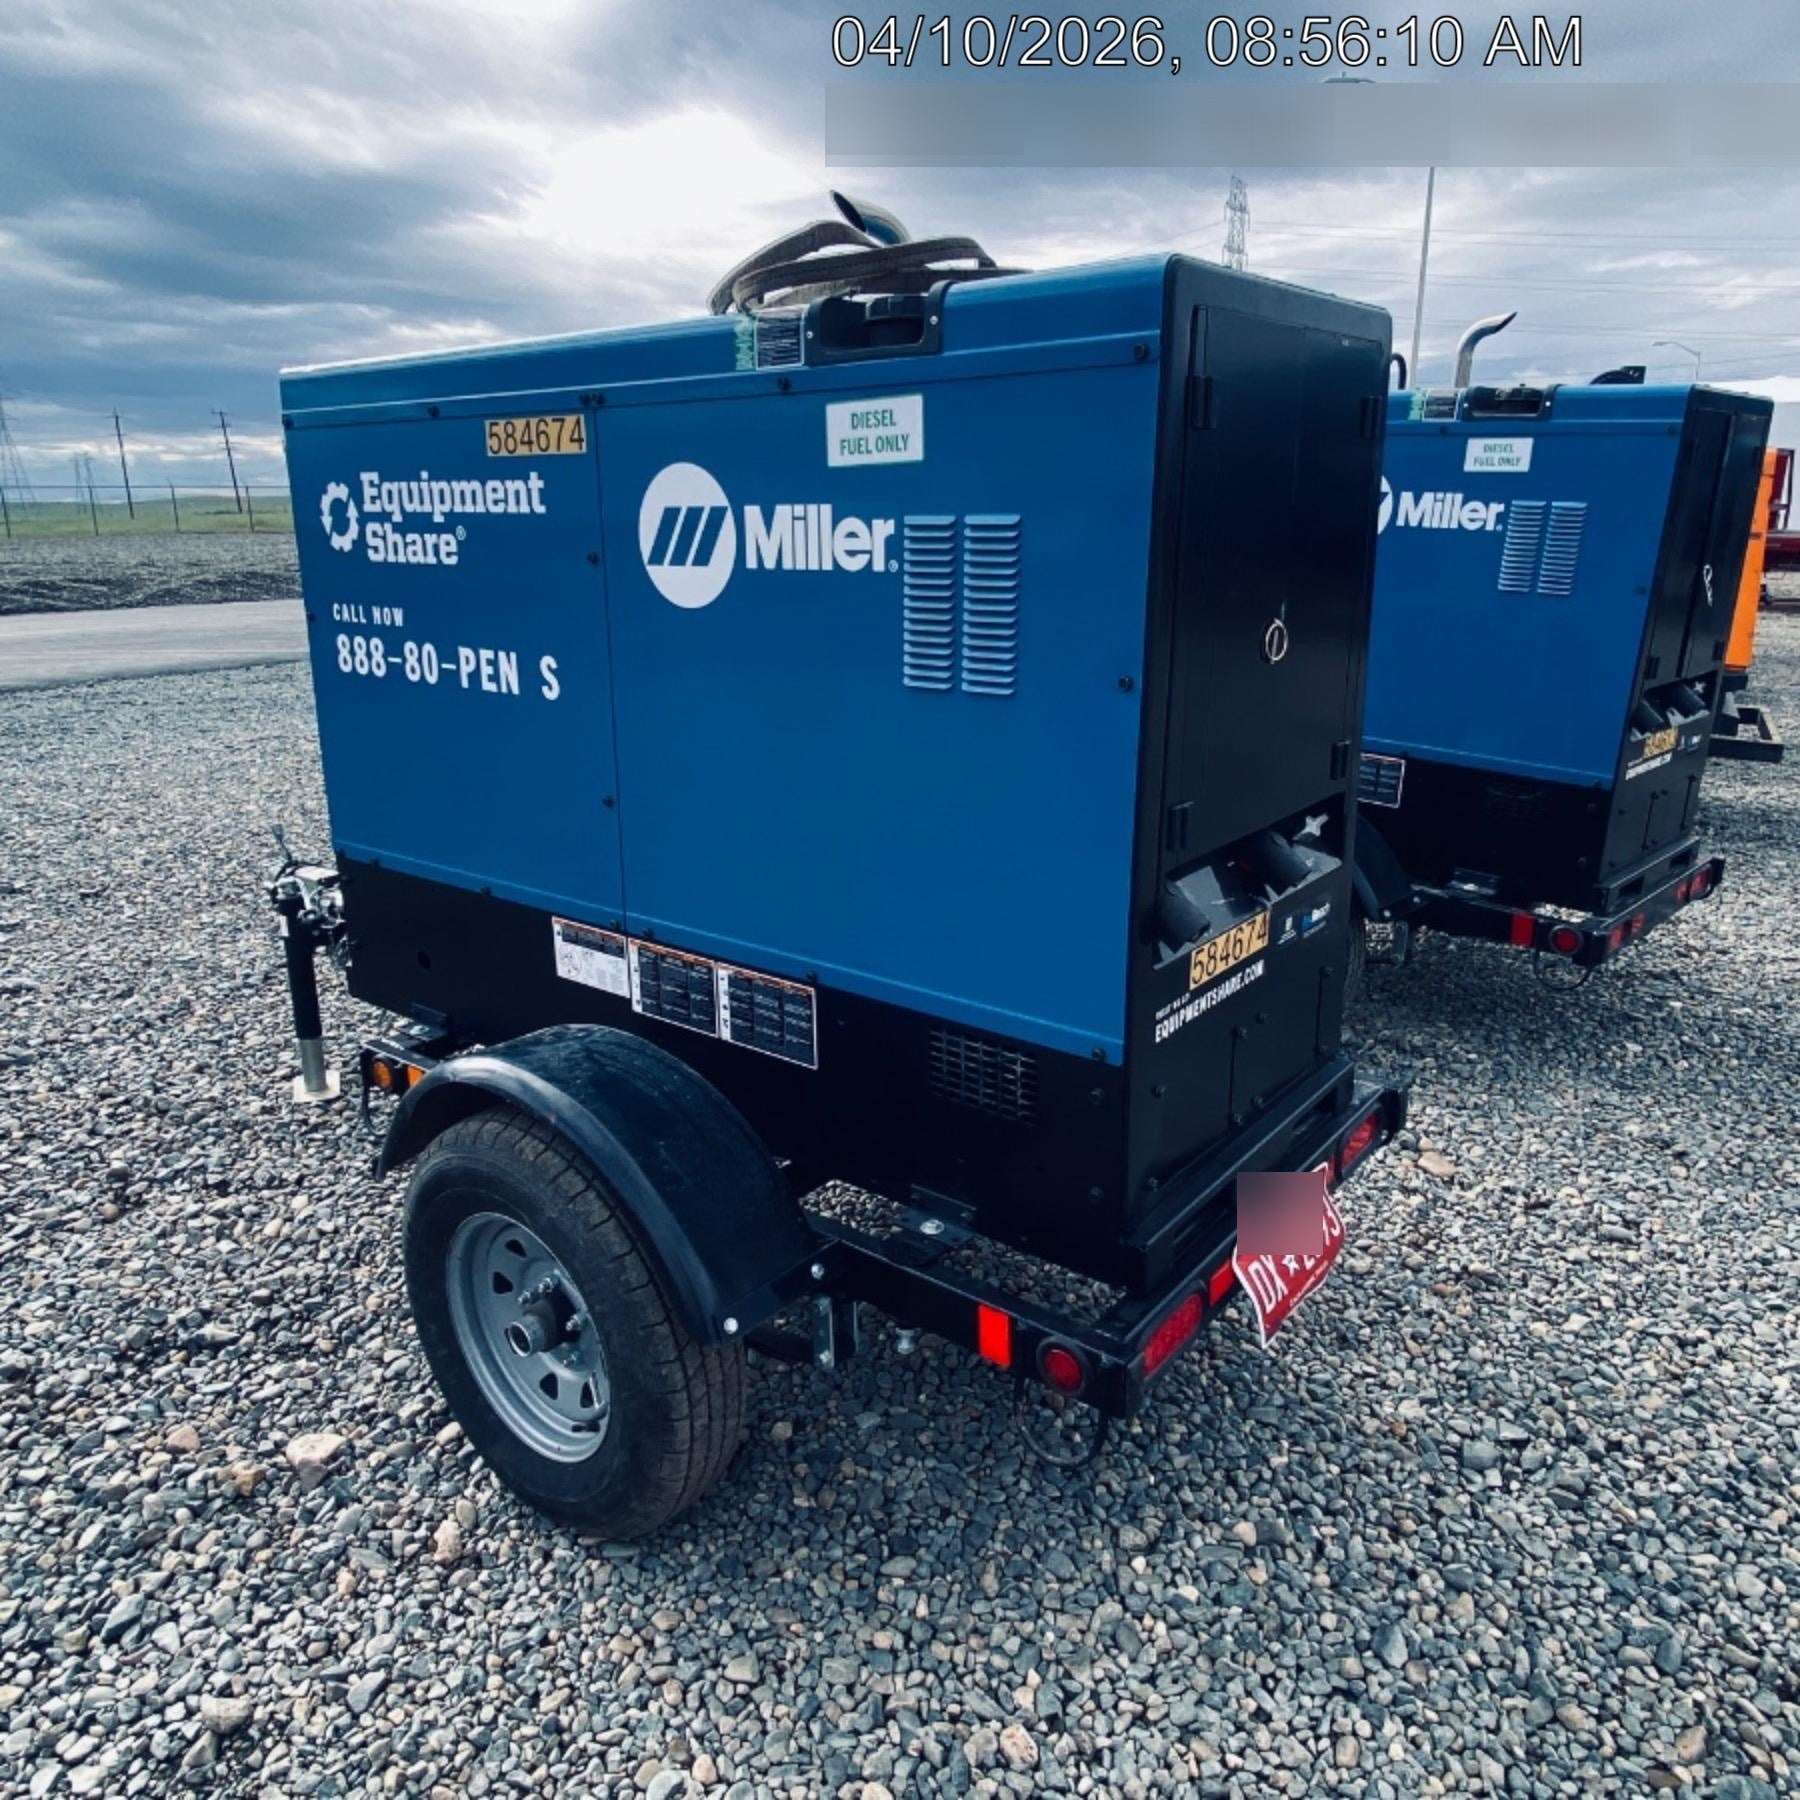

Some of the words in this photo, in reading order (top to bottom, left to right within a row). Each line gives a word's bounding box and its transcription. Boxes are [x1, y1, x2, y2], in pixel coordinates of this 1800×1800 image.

[488, 417, 584, 454] 584674
[851, 408, 896, 430] DIESEL
[839, 436, 873, 456] FUEL
[875, 432, 910, 454] ONLY
[360, 470, 547, 523] Equipment
[1396, 491, 1505, 531] Miller
[743, 503, 896, 573] Miller
[333, 603, 367, 624] CALL
[371, 606, 404, 627] NOW
[1191, 913, 1268, 985] 584674
[1155, 959, 1266, 1044] EQUIPMENTSHARE.COM
